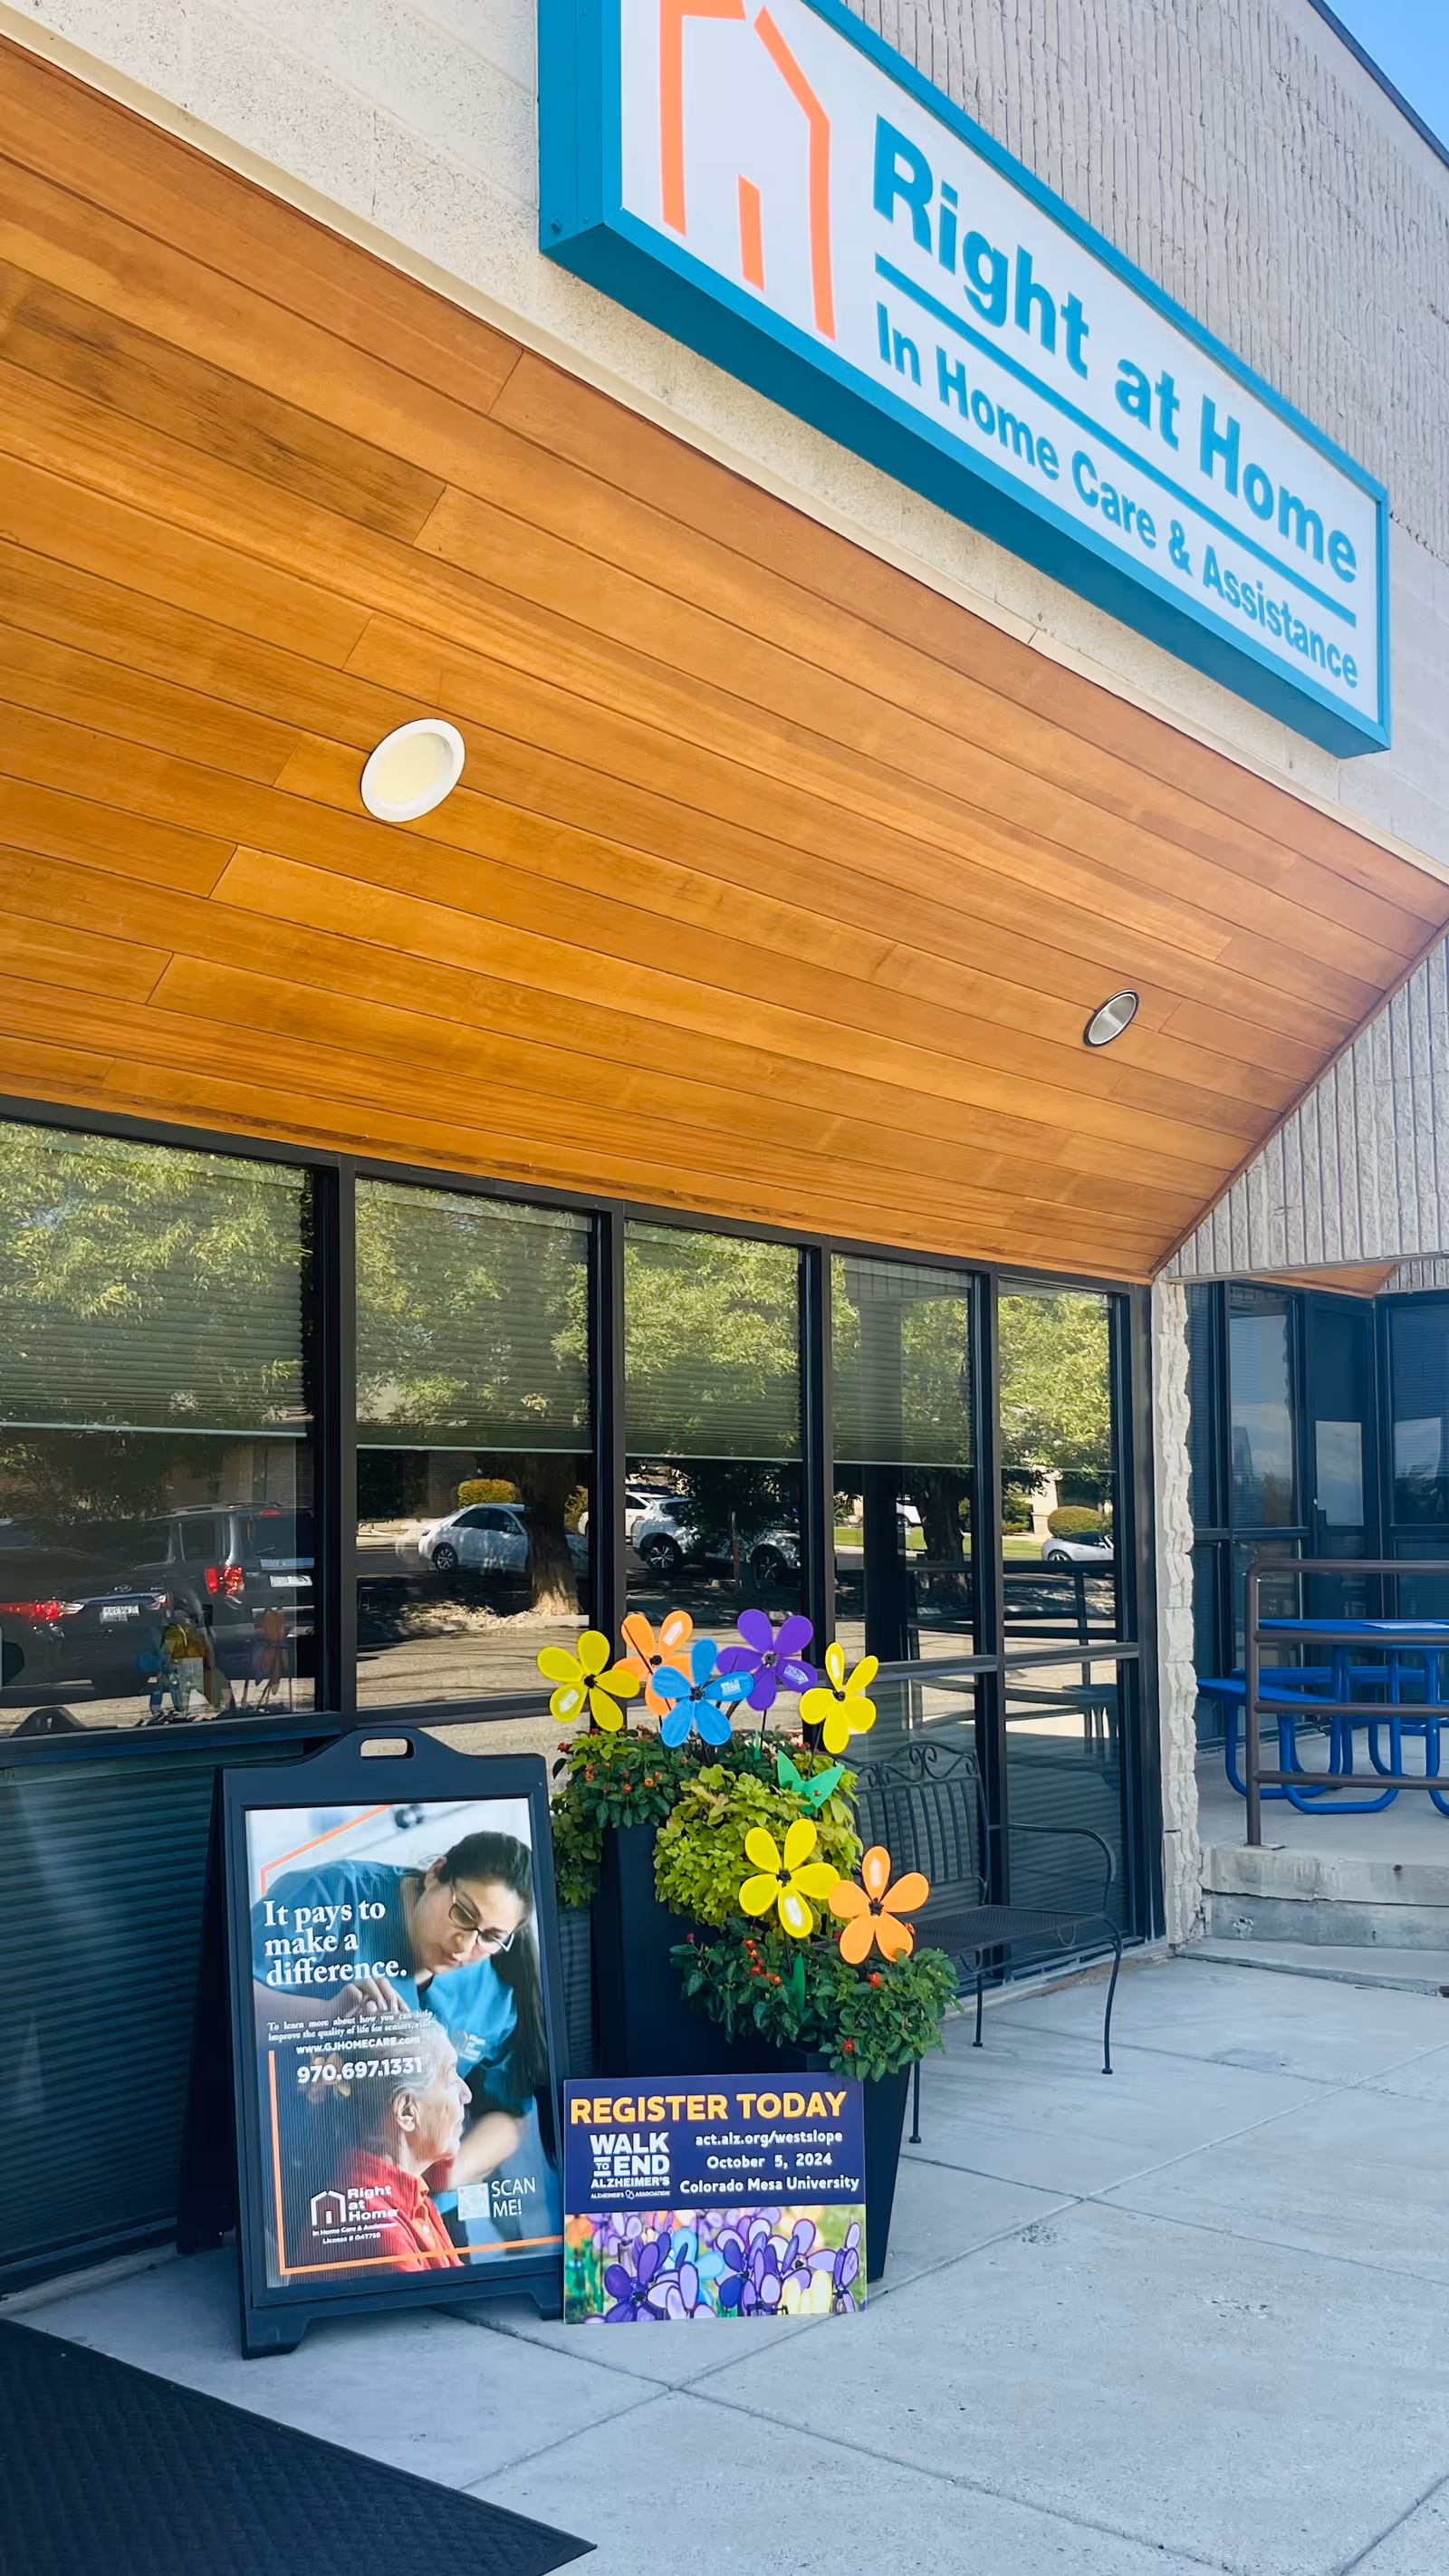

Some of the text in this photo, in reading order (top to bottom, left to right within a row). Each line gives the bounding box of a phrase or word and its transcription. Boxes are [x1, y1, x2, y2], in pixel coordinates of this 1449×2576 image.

[873, 113, 1358, 583] Right at Home
[876, 301, 1358, 689] In Home Care & Assistance
[264, 1899, 386, 1933] It pays to
[264, 1927, 360, 1956] make a
[266, 1956, 408, 1986] difference.
[267, 2022, 280, 2032] To
[283, 2020, 304, 2030] learn
[309, 2020, 330, 2028] more
[332, 2016, 356, 2026] about
[360, 2014, 377, 2023] how
[380, 2014, 395, 2023] you
[268, 2033, 302, 2043] improve
[302, 2030, 316, 2039] the
[318, 2026, 345, 2040] quality
[346, 2025, 356, 2034] of
[356, 2023, 369, 2034] life
[371, 2023, 383, 2033] for
[295, 2036, 421, 2055] www.GJHOMECARE.com
[296, 2056, 422, 2084] 970.697.1331
[571, 2091, 848, 2124] REGISTER TODAY
[590, 2131, 670, 2155] WALK
[696, 2129, 843, 2148] act.alz.org/westslope
[596, 2154, 670, 2177] TO END
[706, 2152, 832, 2170] October 5, 2024
[347, 2185, 392, 2200] Right
[491, 2177, 536, 2197] SCAN
[590, 2176, 670, 2189] ALZHEIMER'S
[679, 2174, 859, 2194] Colorado Mesa University
[635, 2190, 671, 2198] ASSOCIATION
[348, 2199, 366, 2211] at
[349, 2208, 398, 2222] Home
[493, 2198, 523, 2218] ME!
[341, 2225, 357, 2234] Care
[322, 2236, 348, 2244] License
